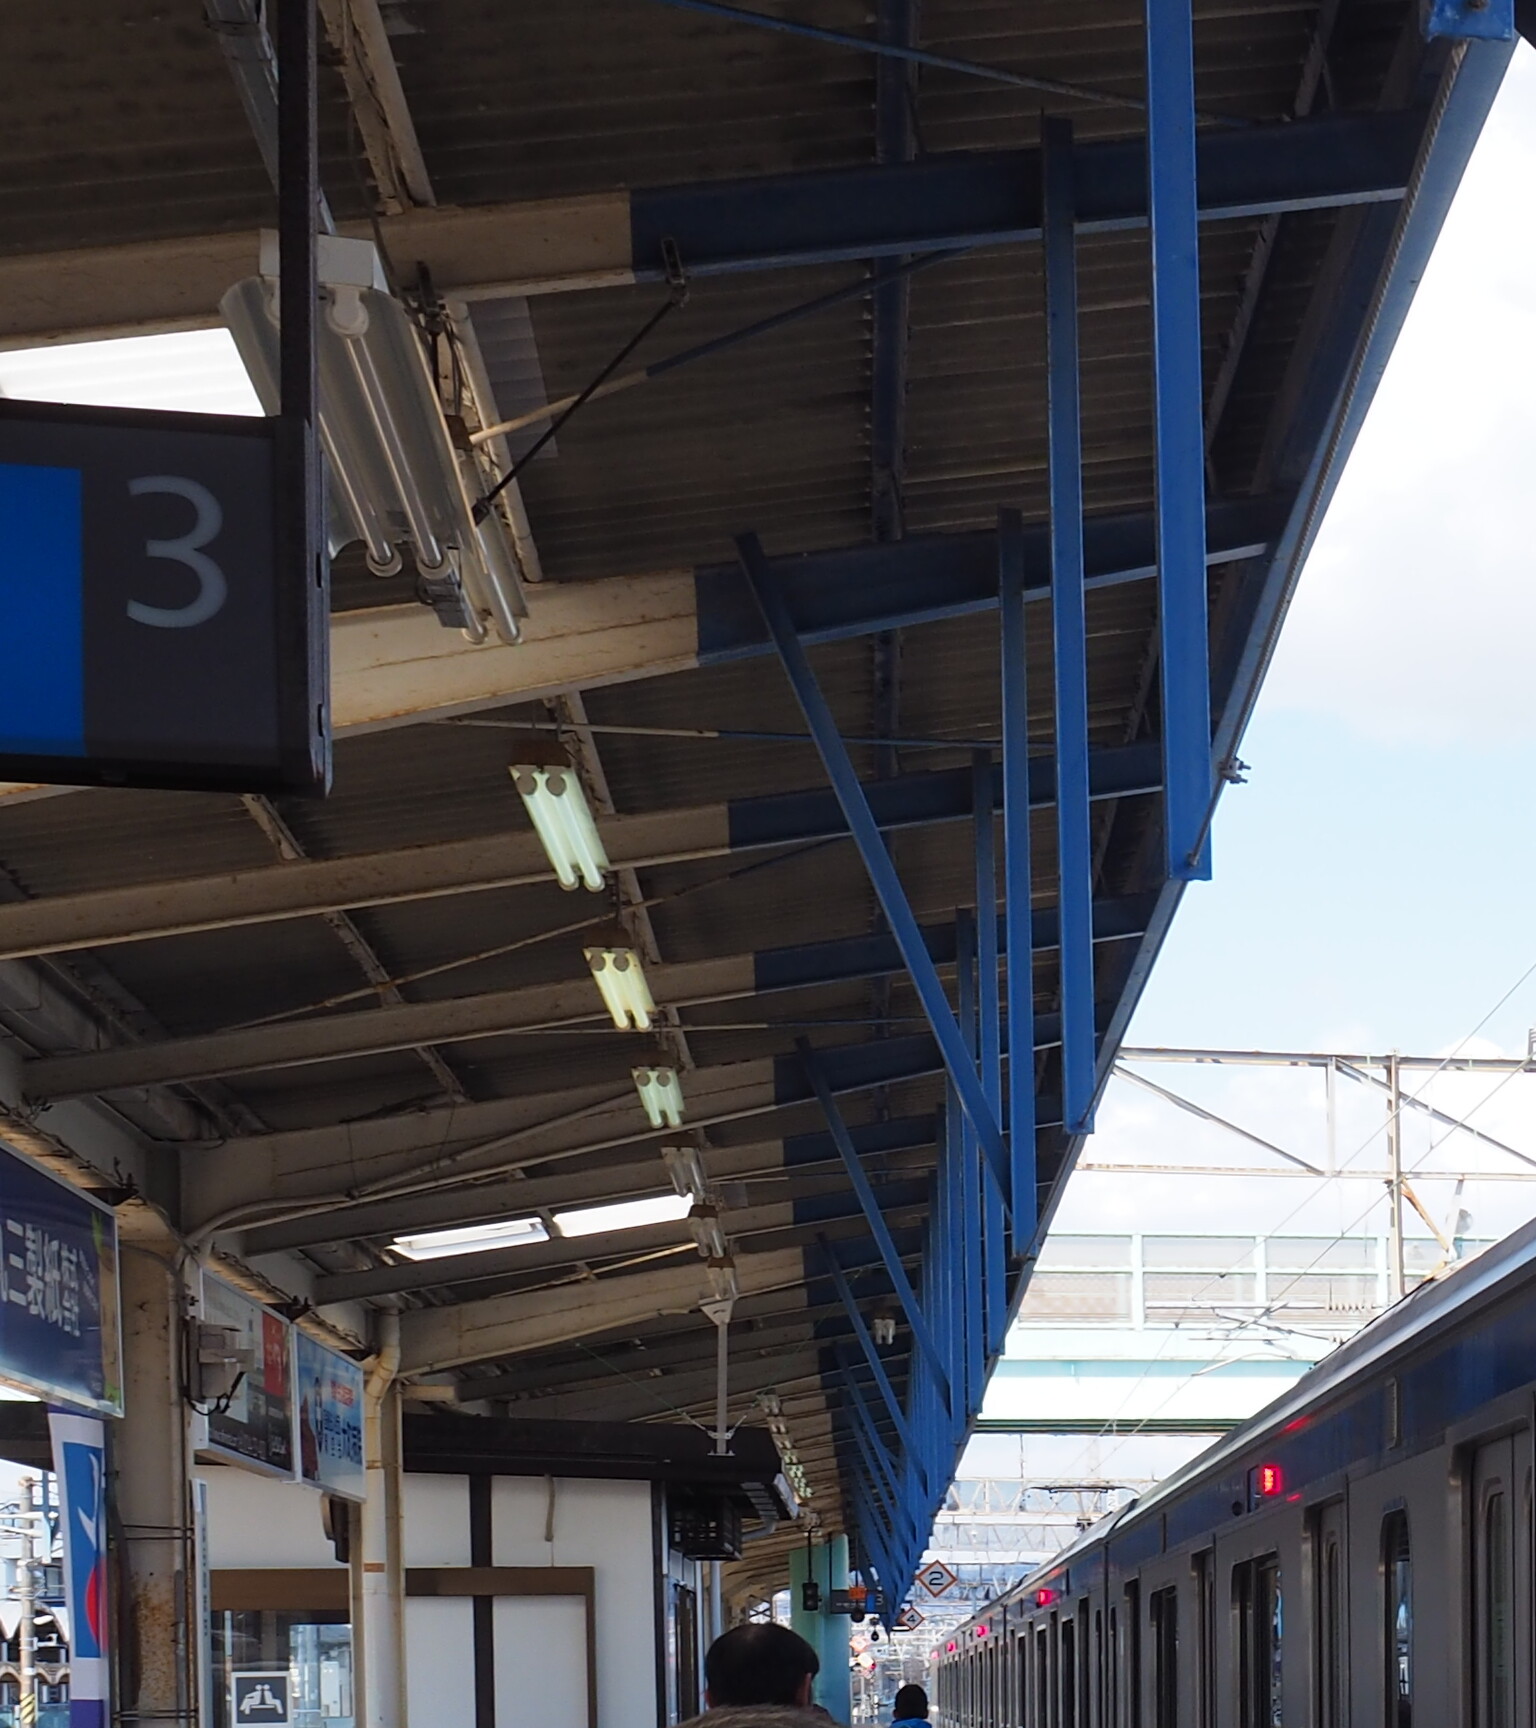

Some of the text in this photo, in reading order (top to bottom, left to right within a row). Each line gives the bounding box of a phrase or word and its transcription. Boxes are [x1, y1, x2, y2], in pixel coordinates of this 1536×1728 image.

[126, 475, 228, 628] 3
[928, 1571, 944, 1586] 2
[907, 1614, 917, 1623] 4
